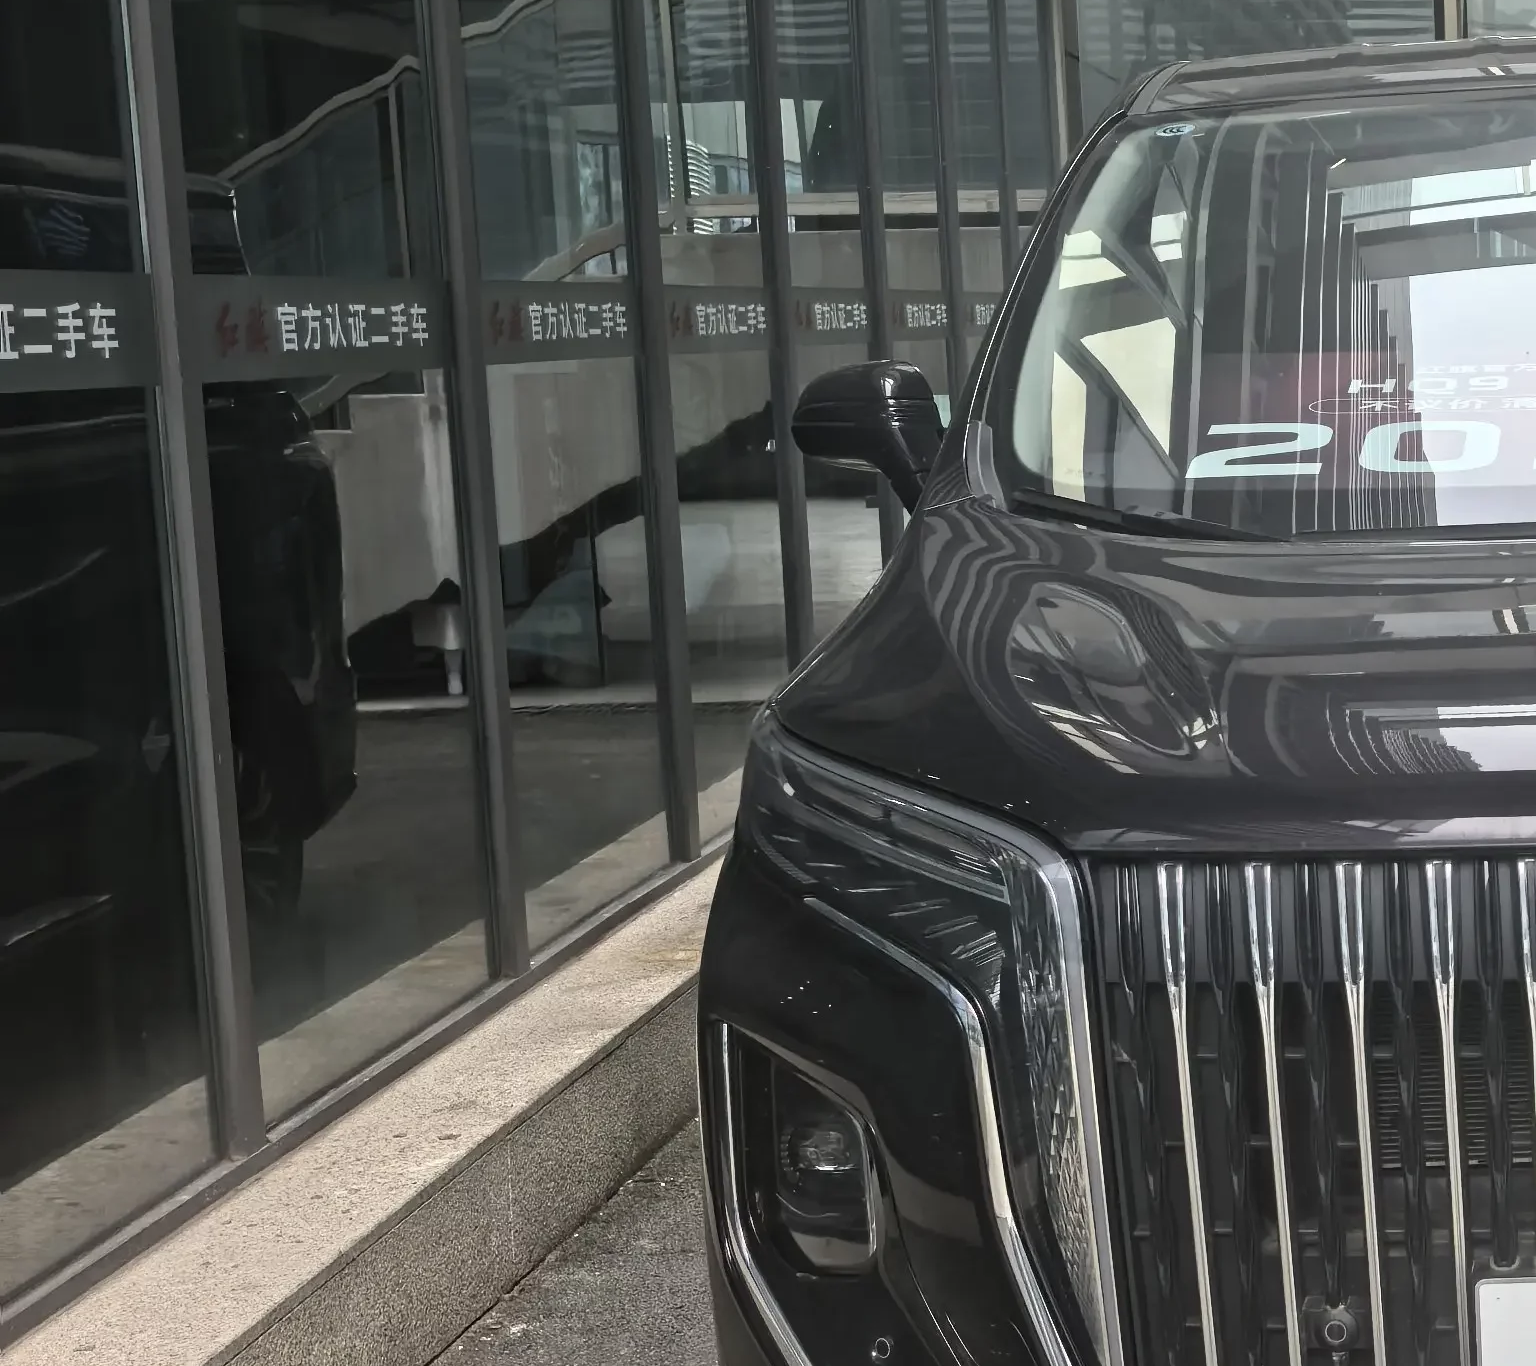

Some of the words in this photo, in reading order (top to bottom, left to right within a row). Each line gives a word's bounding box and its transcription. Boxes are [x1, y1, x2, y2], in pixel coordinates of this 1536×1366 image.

[277, 302, 429, 352] 官方认证二手车
[529, 301, 628, 341] 官方认证二手车
[696, 303, 767, 335] 官方认证二手车
[1347, 375, 1509, 395] HQ9
